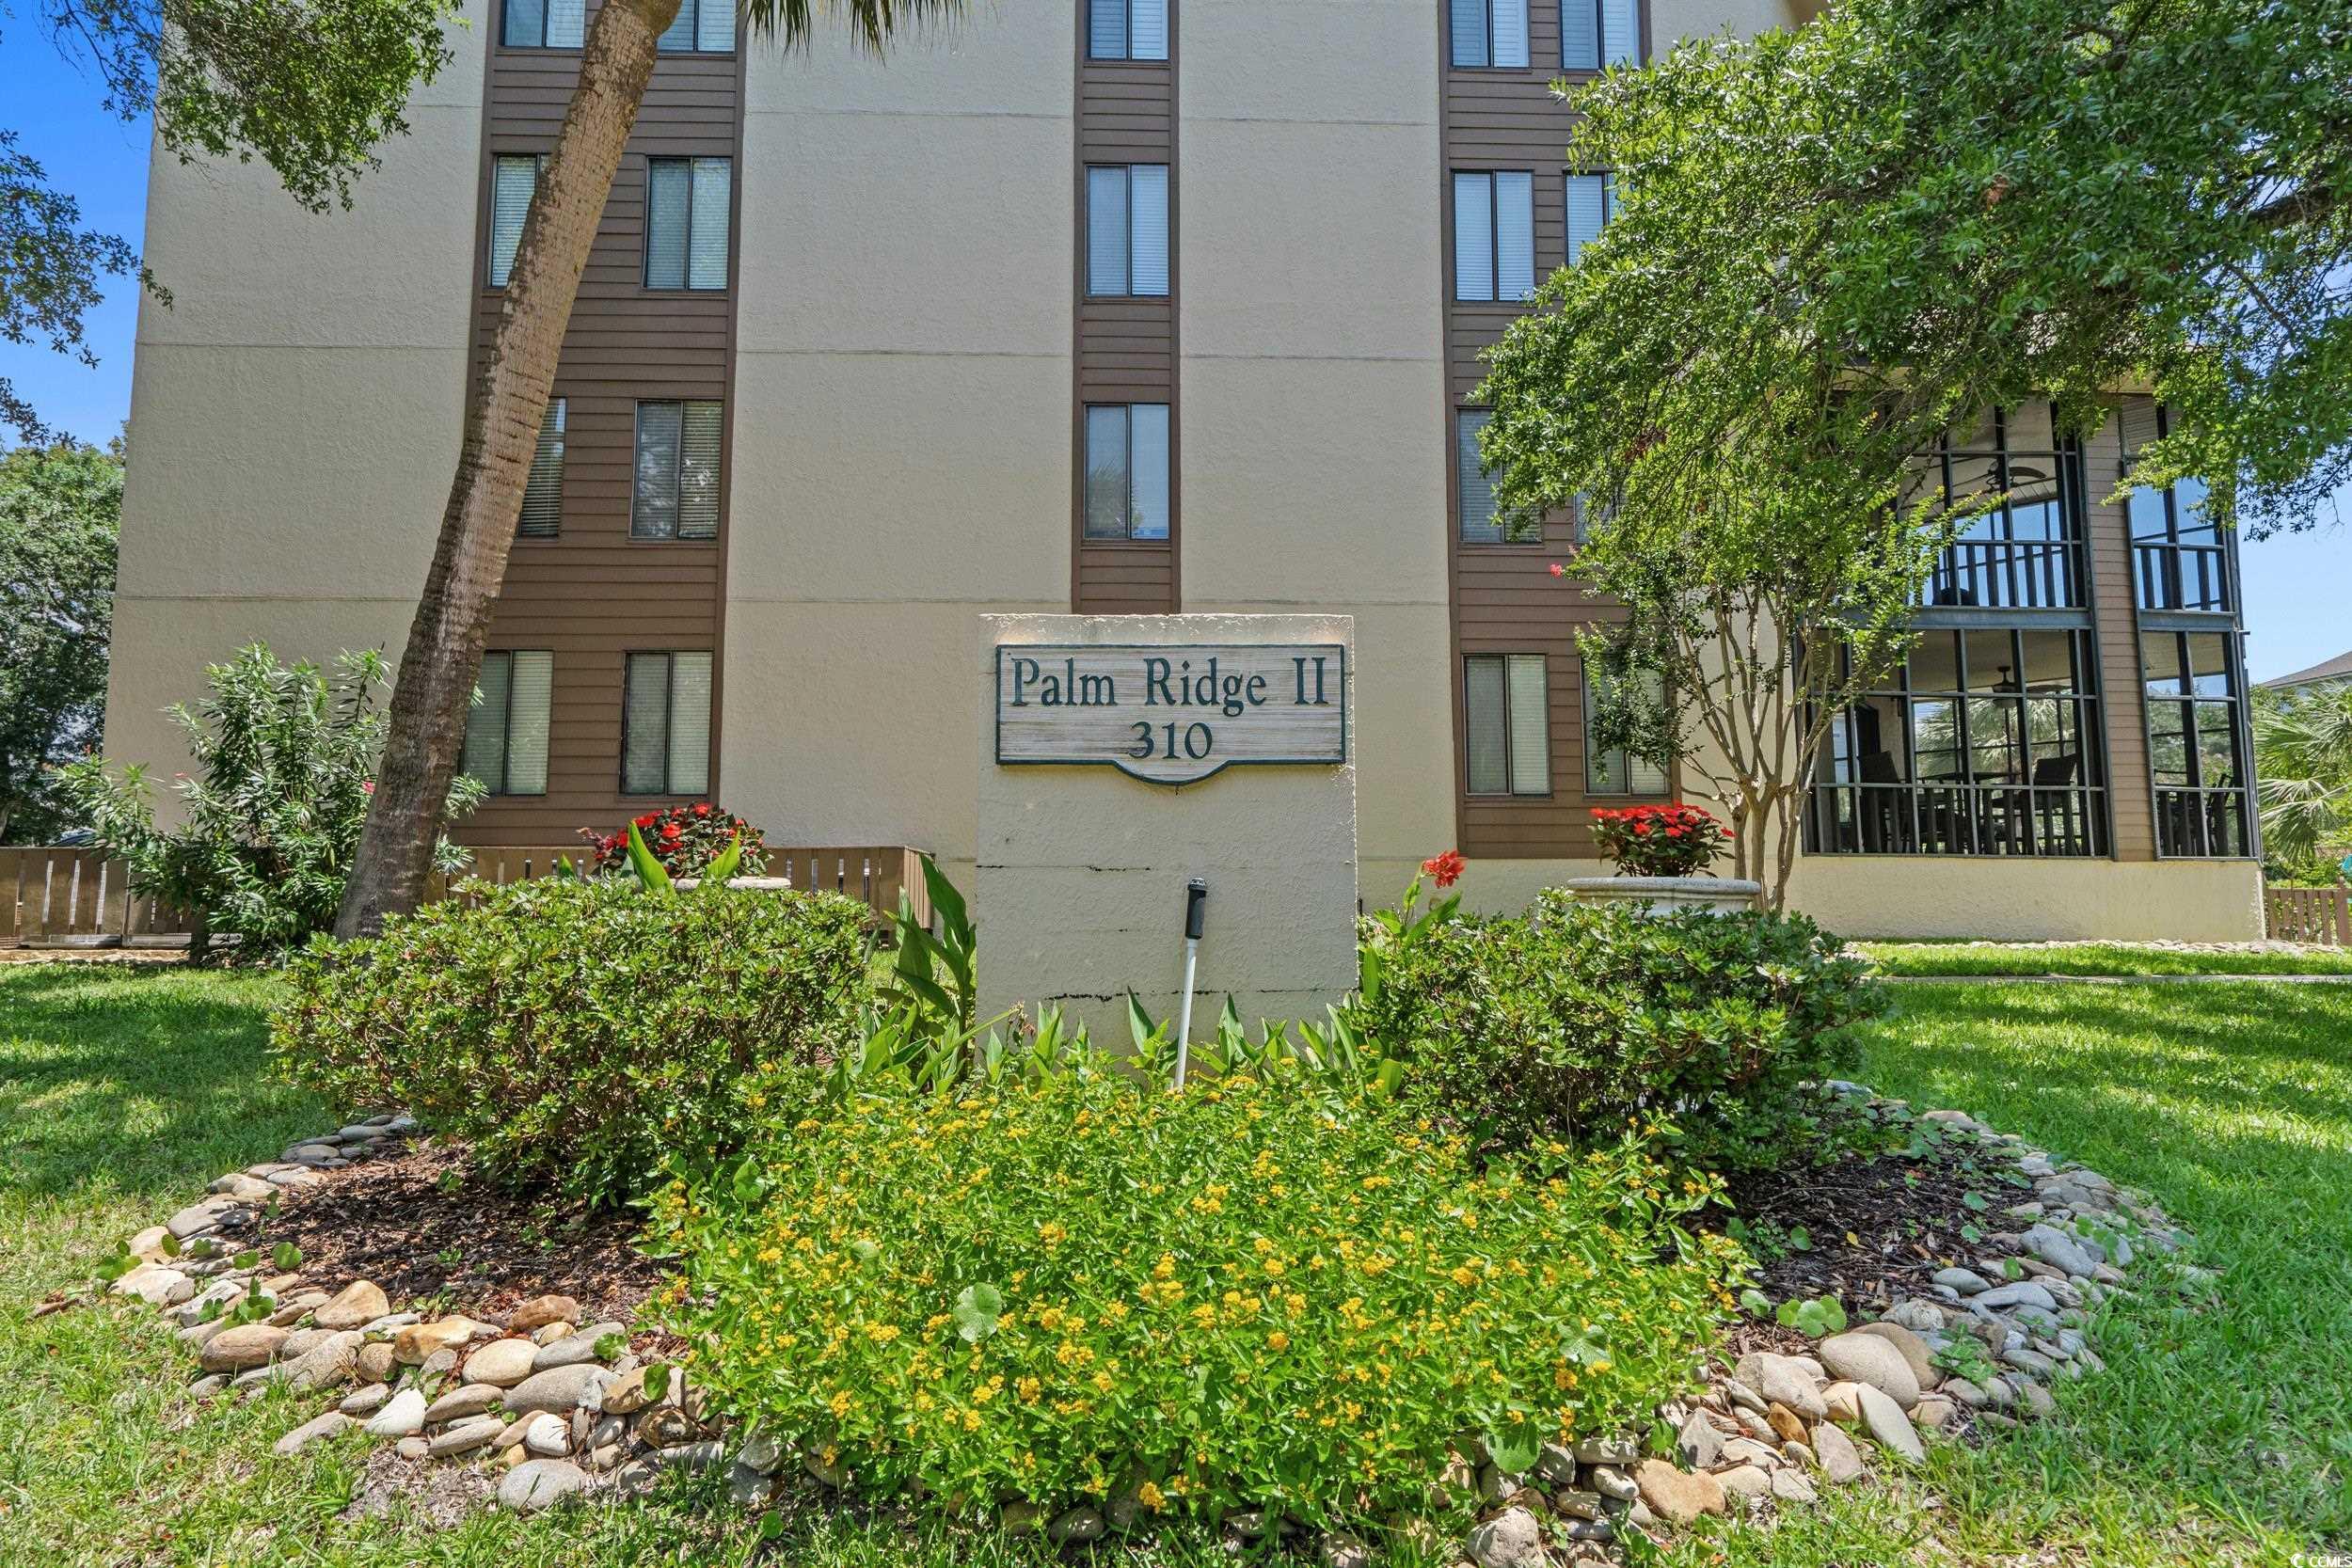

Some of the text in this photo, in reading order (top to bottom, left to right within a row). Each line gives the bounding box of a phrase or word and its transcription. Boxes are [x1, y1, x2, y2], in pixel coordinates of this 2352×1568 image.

[1010, 657, 1329, 717] Palm Ridge II
[1128, 721, 1214, 760] 310
